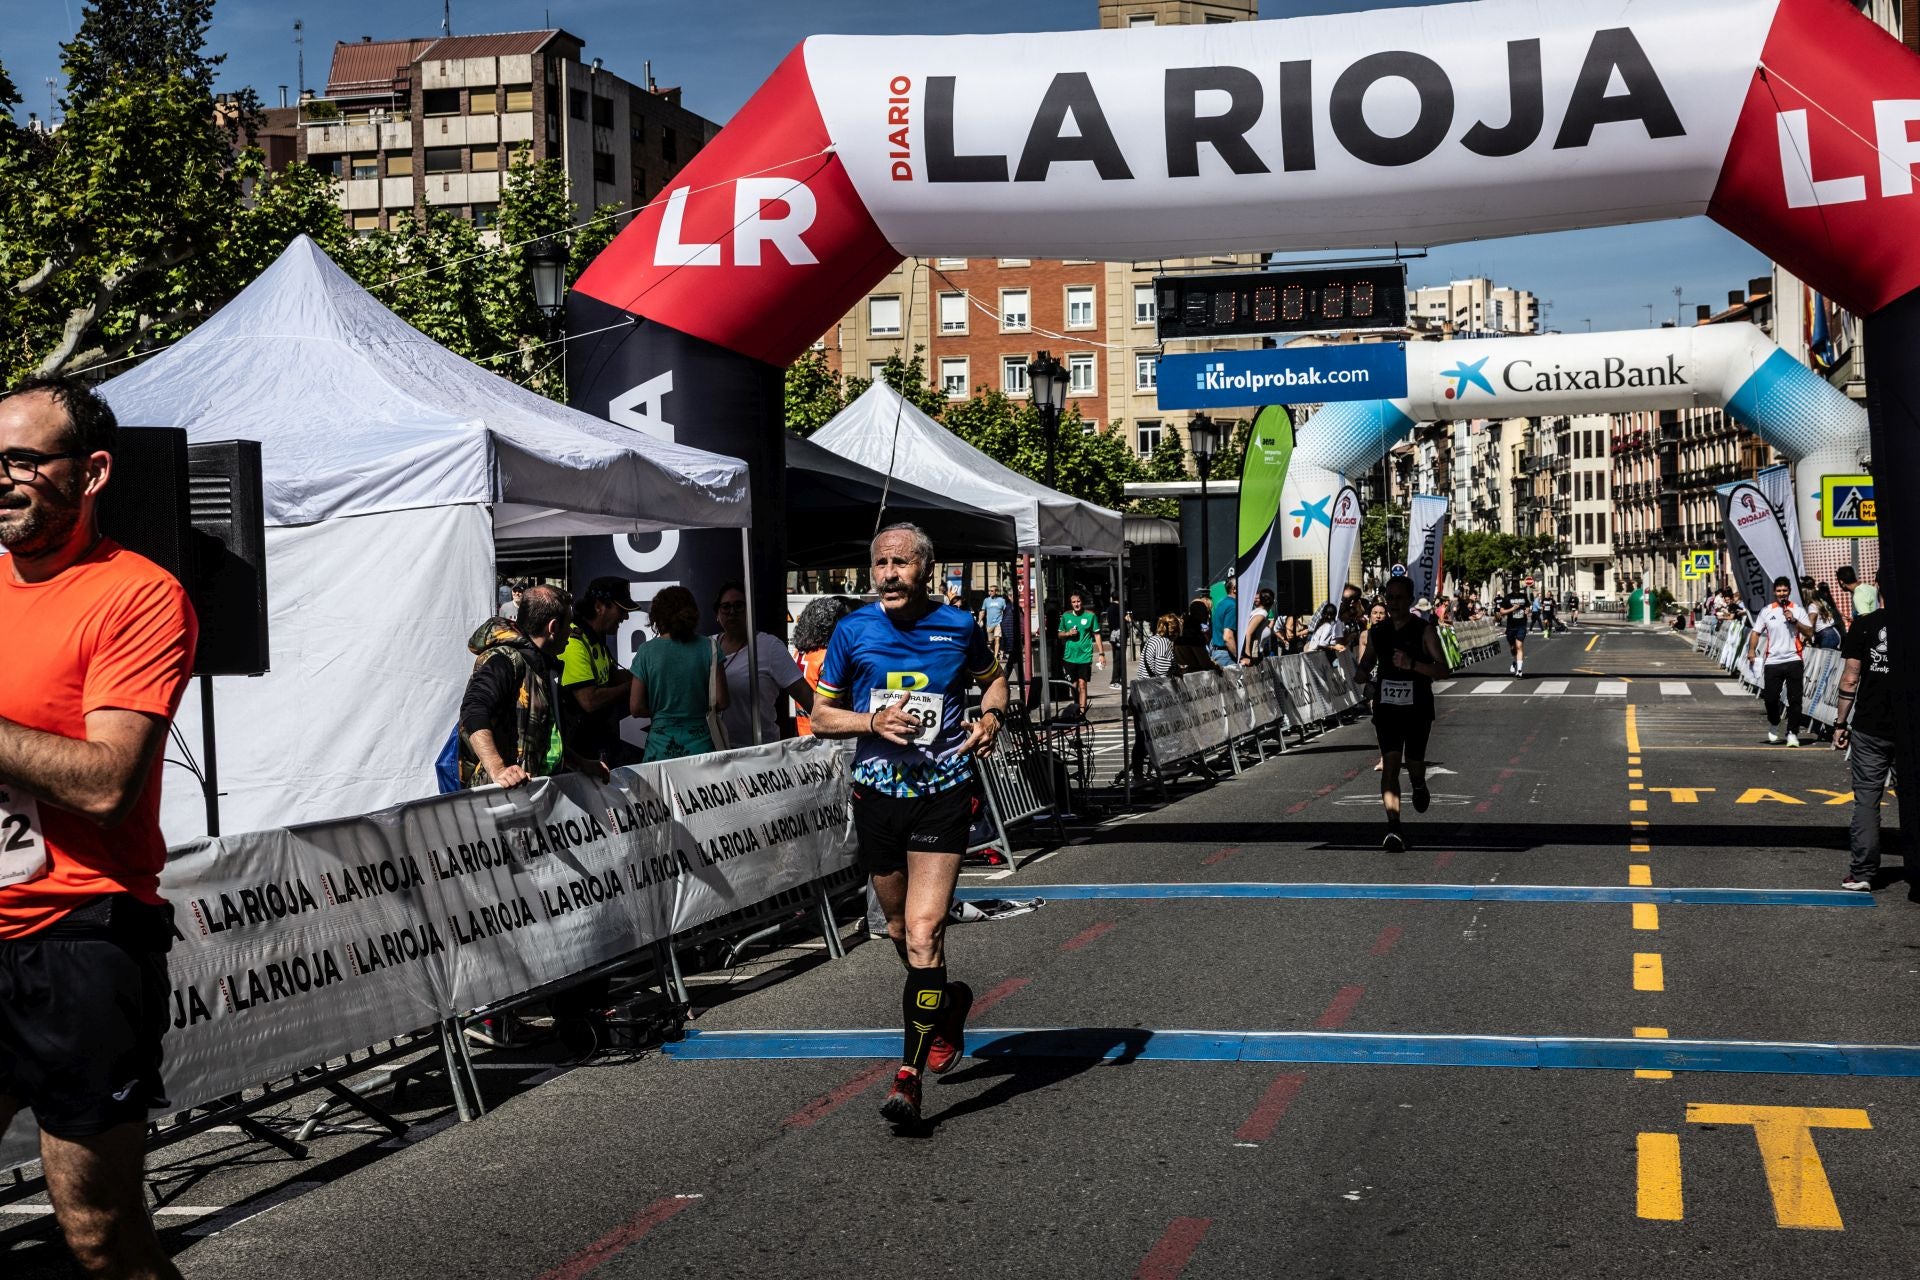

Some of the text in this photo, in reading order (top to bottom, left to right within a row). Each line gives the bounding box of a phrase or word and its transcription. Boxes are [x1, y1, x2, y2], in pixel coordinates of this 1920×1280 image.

[888, 26, 1687, 183] DIARIO LA RIOJA
[653, 177, 820, 267] LR
[1206, 366, 1369, 393] Kirolprobak.com
[1502, 353, 1689, 393] CaixaBank
[609, 369, 684, 673] RIOA
[1419, 523, 1437, 598] ixaBank
[883, 693, 921, 702] CARRA
[1383, 687, 1411, 699] 1277
[696, 780, 741, 812] RIOJA
[740, 774, 764, 799] LA
[756, 767, 795, 797] RIOJA
[1649, 787, 1897, 805] TAX
[613, 803, 640, 834] LA
[636, 797, 672, 828] RIOJA
[677, 788, 701, 816] LA
[522, 828, 551, 859] LA
[548, 813, 607, 850] RIOJA
[432, 846, 458, 880] LA
[461, 834, 516, 872] RIOJA
[320, 873, 335, 906] DIARIO
[326, 867, 363, 905] LA
[359, 855, 425, 899] RIOJA
[199, 892, 245, 934] LA
[219, 976, 233, 1014] DIARIO
[227, 967, 270, 1012] LA
[266, 949, 343, 1001] RIOJA
[352, 938, 384, 975] LA
[382, 922, 445, 967] RIOJA
[451, 910, 485, 946] LA
[481, 896, 537, 939] RIOJA
[543, 883, 574, 918] LA
[569, 869, 625, 911] RIOJA
[630, 859, 653, 891] LA
[648, 848, 694, 885] RIOJA
[697, 838, 725, 867] LA
[718, 827, 760, 861] RIOJA
[763, 819, 784, 846] LA
[777, 812, 811, 843] RIOJA
[240, 878, 319, 924] RIOJA
[190, 901, 208, 936] DIARIO
